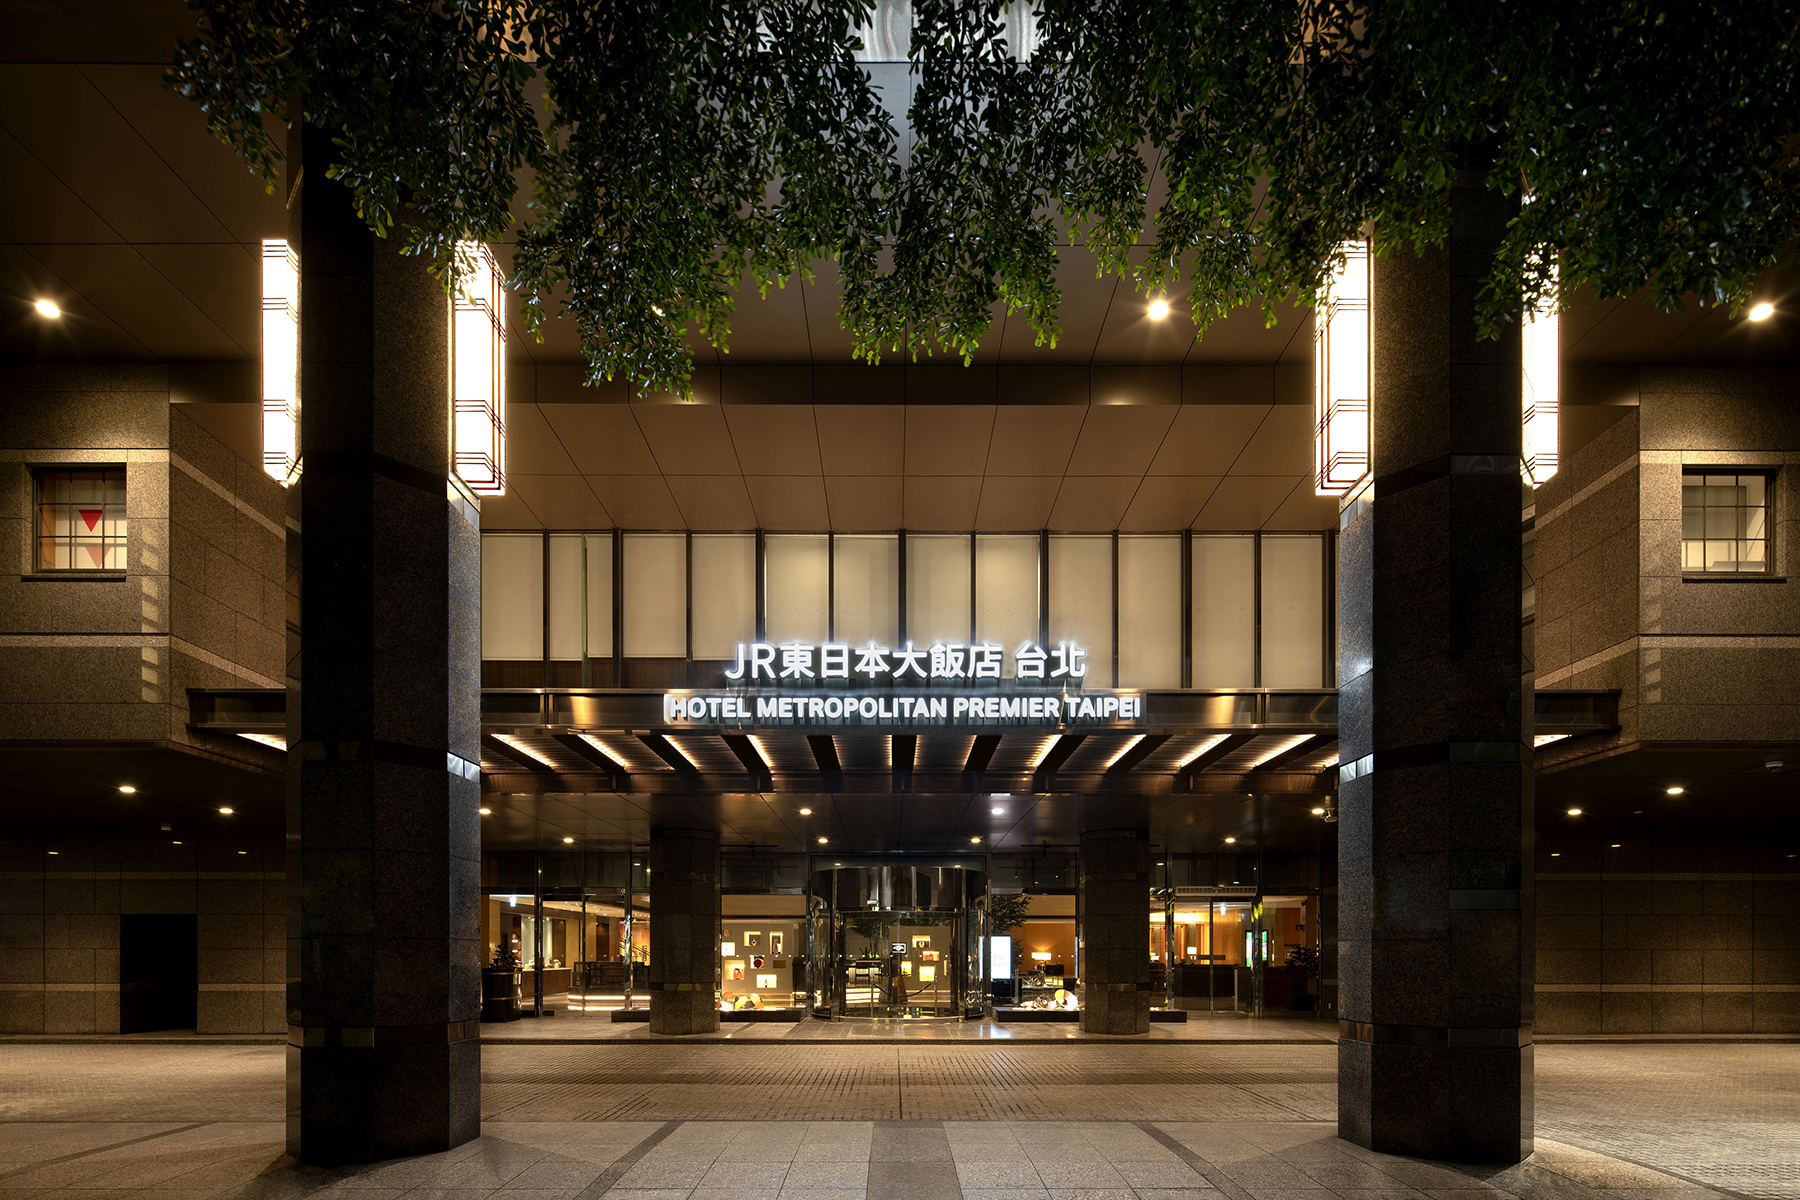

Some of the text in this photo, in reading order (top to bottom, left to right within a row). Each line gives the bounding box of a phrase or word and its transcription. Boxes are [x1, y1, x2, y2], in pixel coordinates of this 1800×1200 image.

[725, 642, 1087, 679] JR東日本大飯店 台北
[672, 697, 1141, 718] HOTEL METROPOLITAN PREMIER TAIPEI
